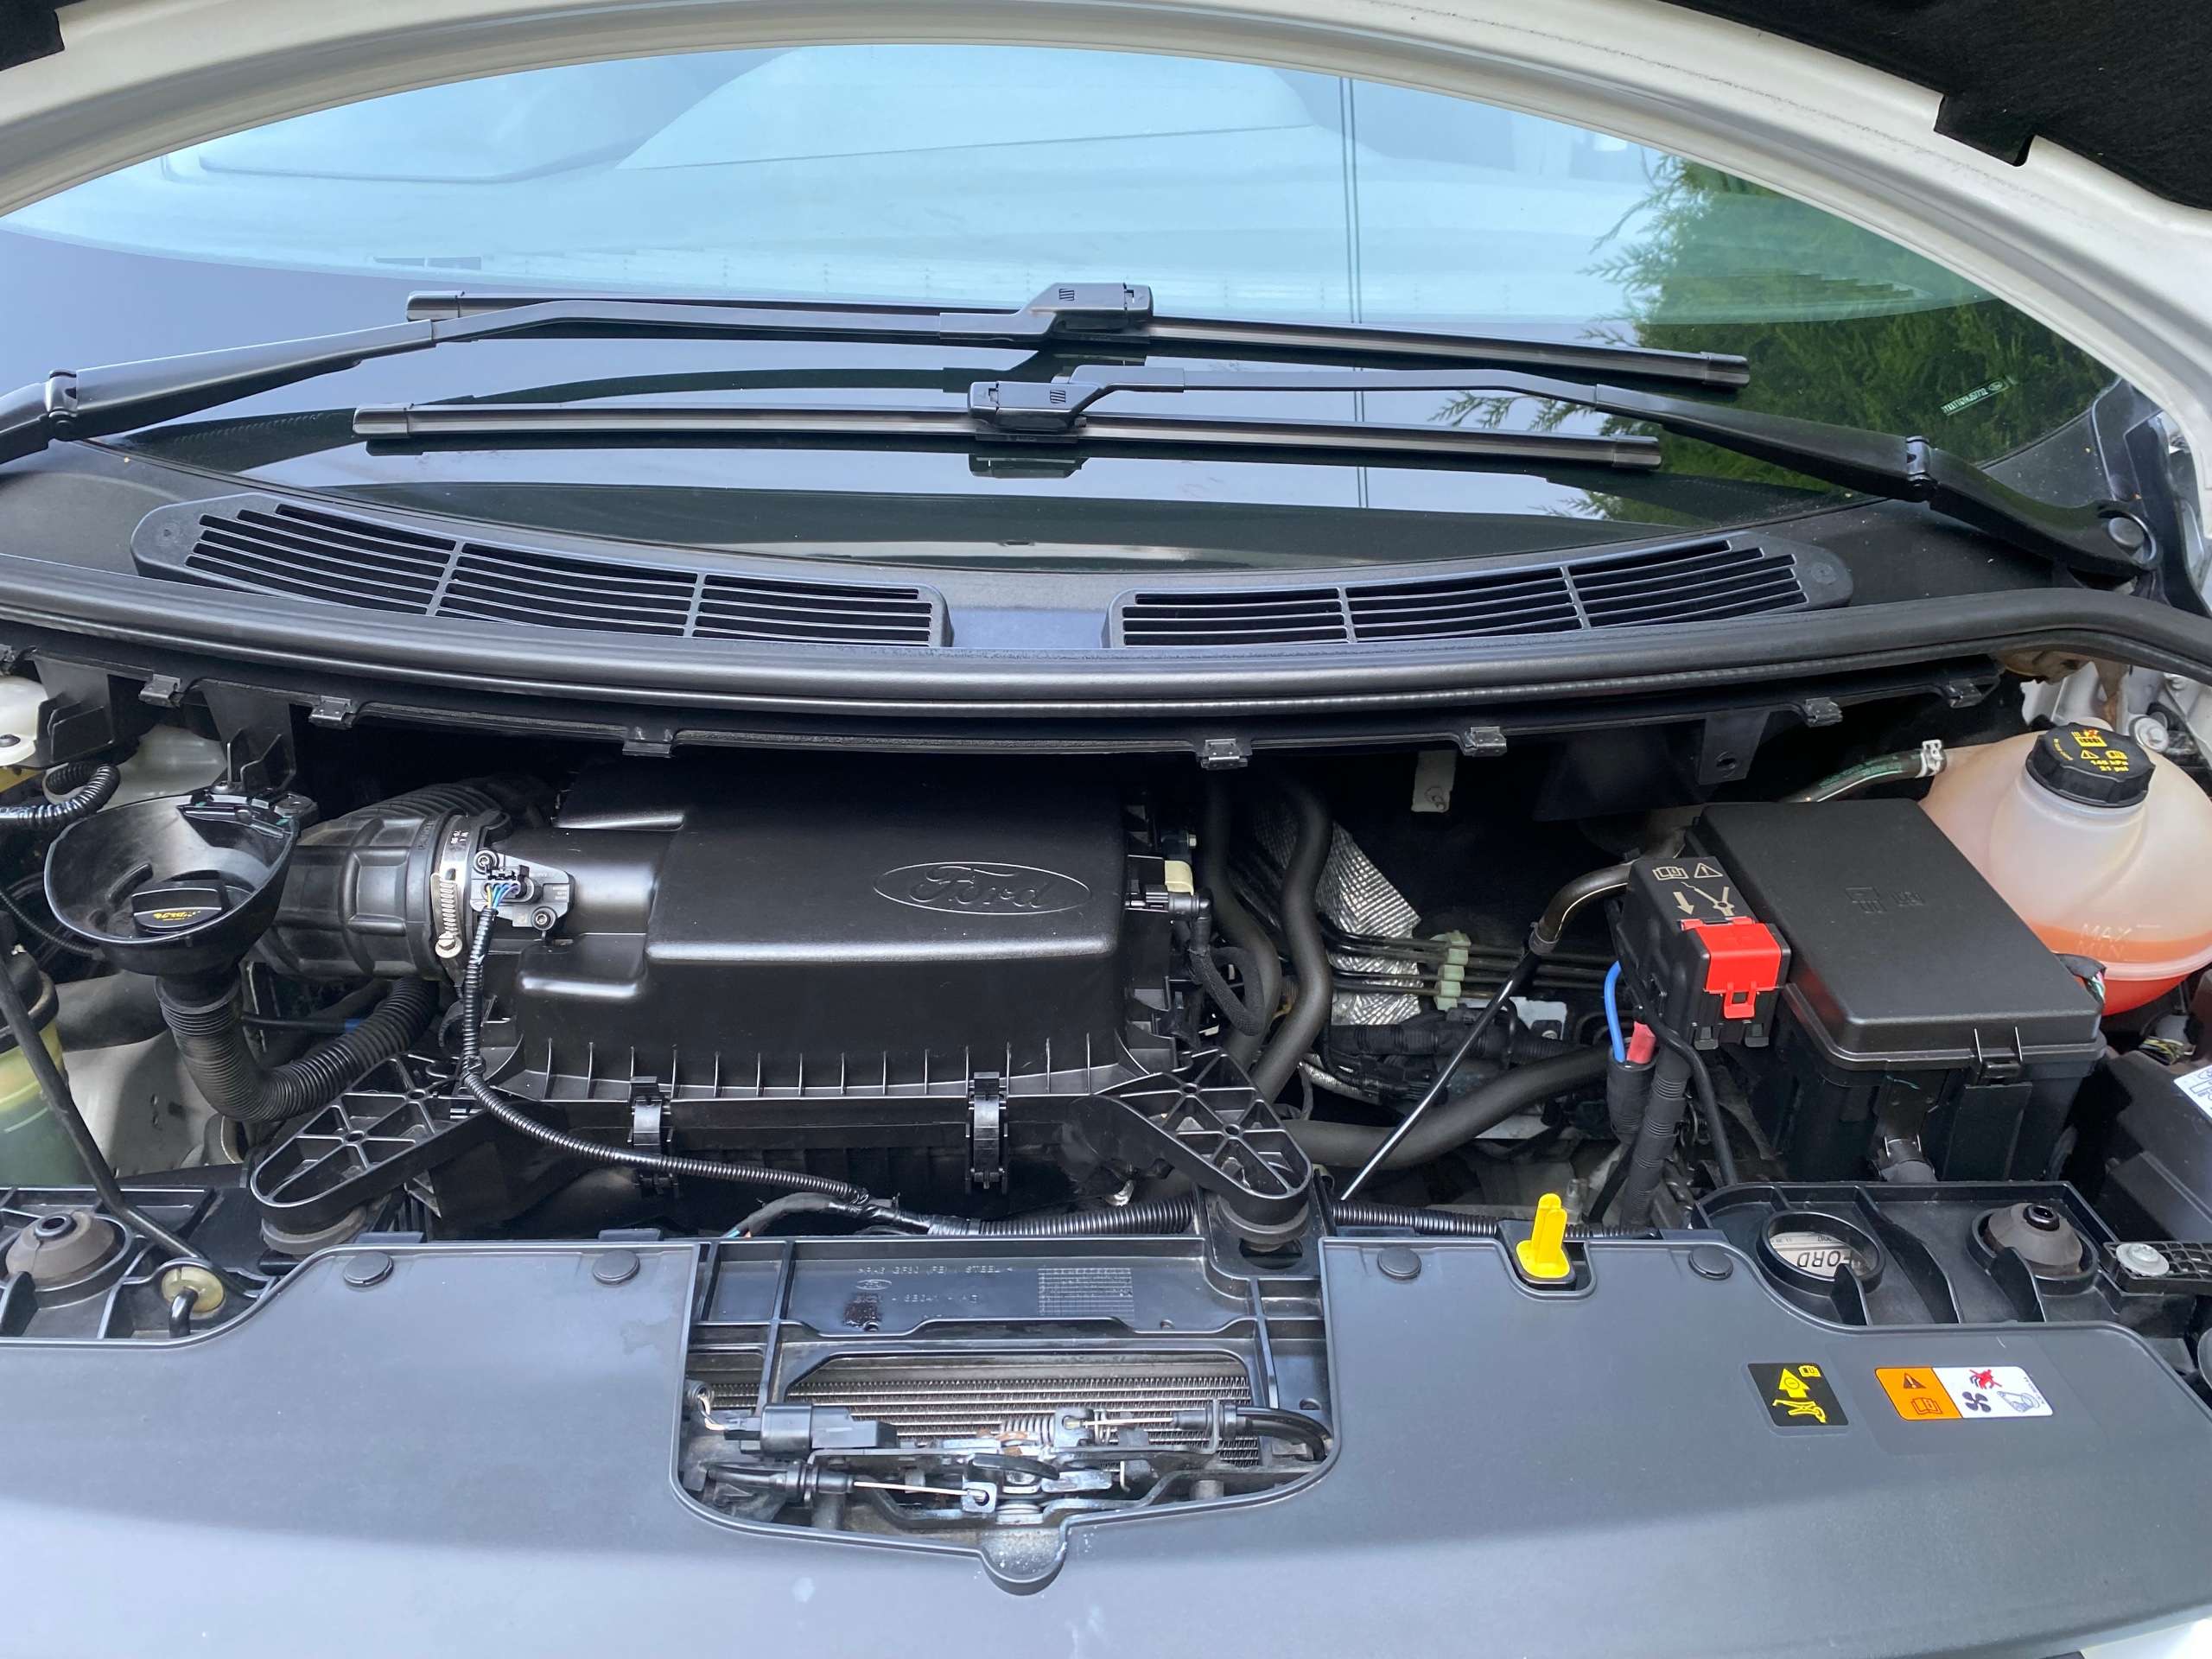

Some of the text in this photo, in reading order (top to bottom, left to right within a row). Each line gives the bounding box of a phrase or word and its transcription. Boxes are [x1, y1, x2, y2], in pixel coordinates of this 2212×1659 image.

[906, 863, 1059, 909] Ford
[2081, 922, 2133, 942] MAX
[2074, 939, 2125, 960] MIN
